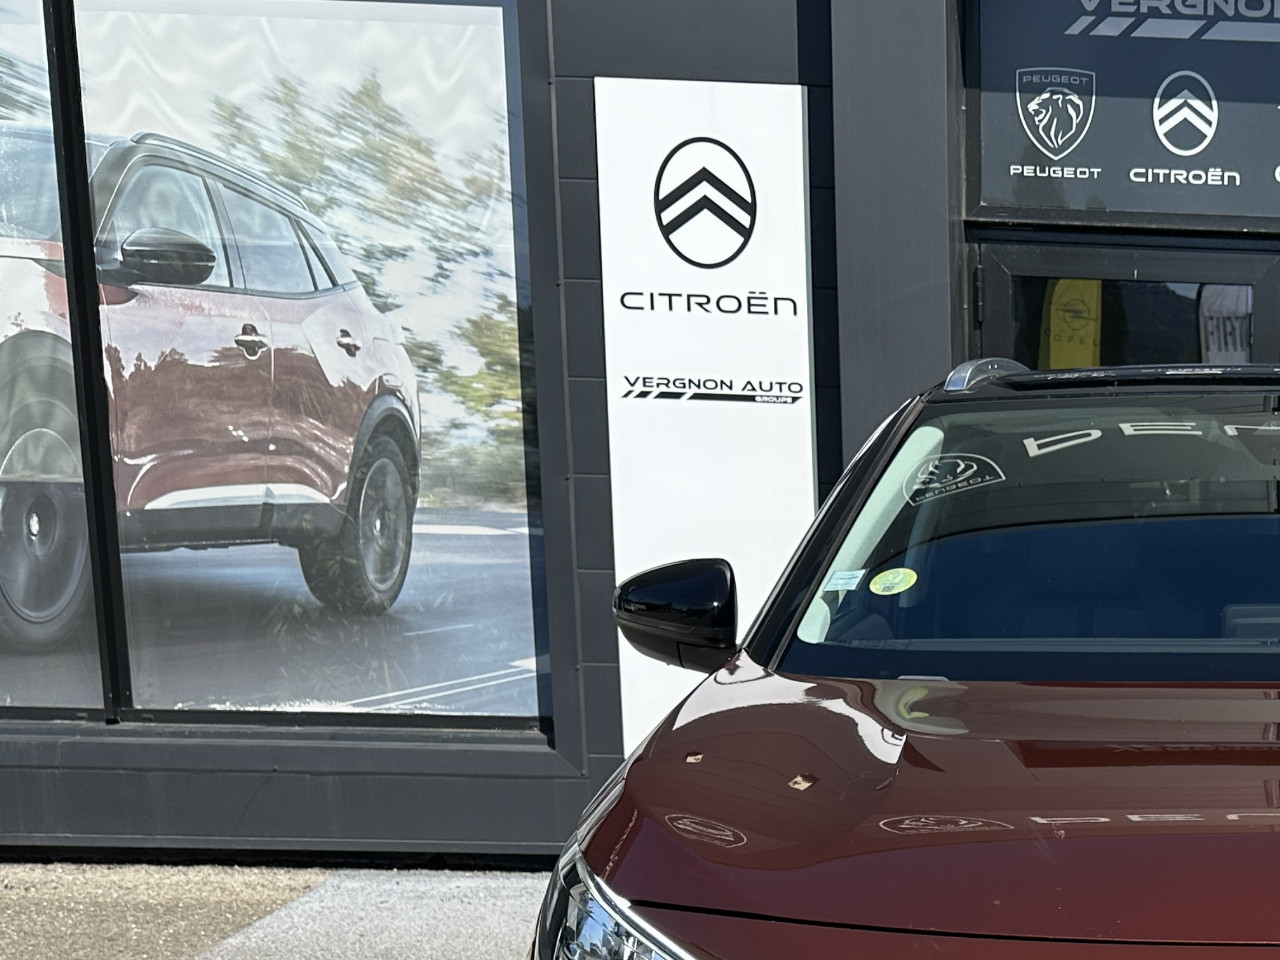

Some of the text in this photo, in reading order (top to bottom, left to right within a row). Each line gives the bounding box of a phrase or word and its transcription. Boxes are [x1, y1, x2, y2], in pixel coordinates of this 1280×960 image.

[1022, 75, 1089, 86] PEUGEOT
[1009, 165, 1101, 180] PEUGEOT
[623, 376, 804, 393] VERGNON AUTO
